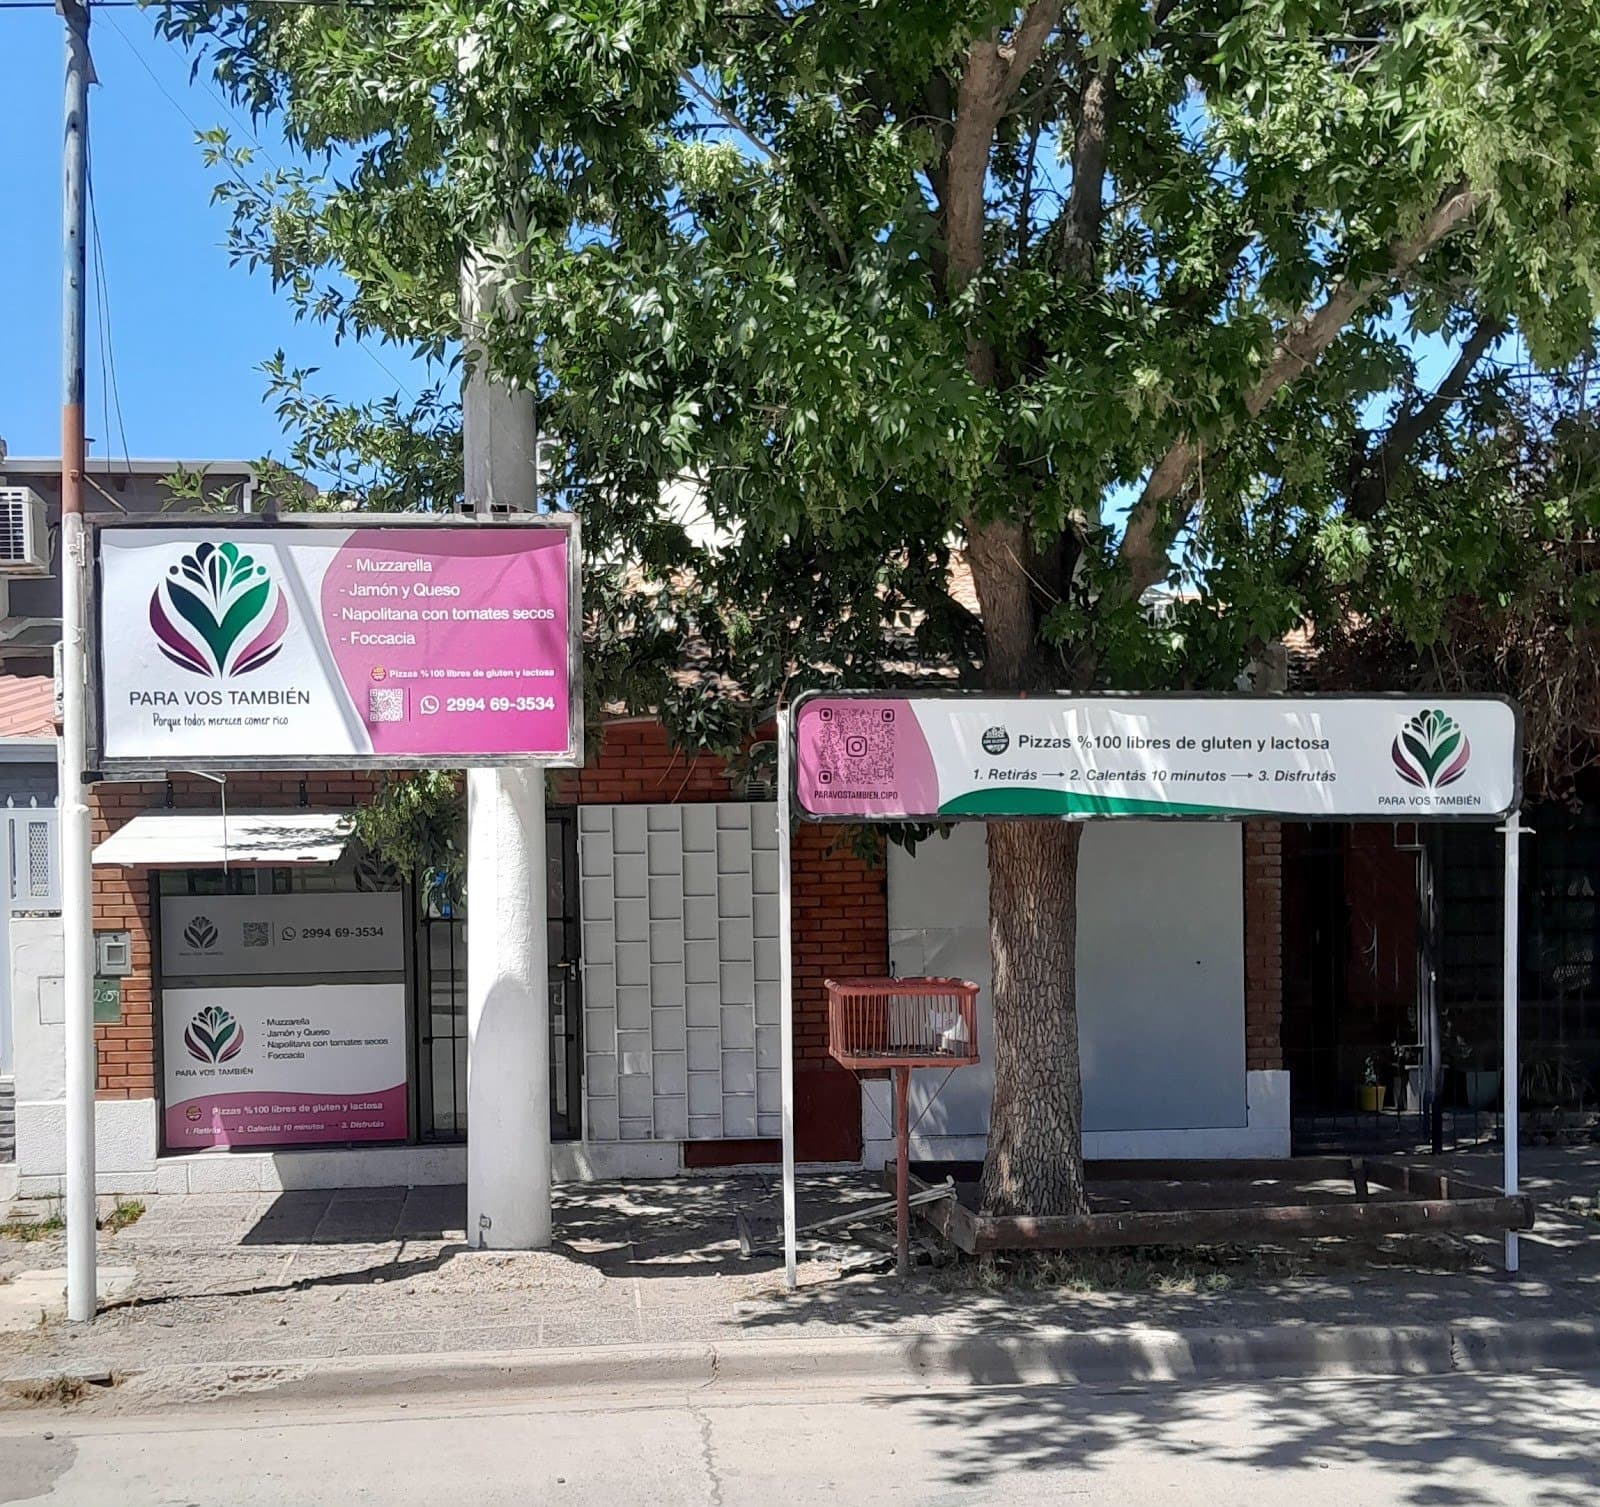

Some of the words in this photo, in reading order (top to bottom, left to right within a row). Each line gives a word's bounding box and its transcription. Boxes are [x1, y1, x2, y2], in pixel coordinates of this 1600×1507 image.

[356, 559, 433, 572] Muzzarella
[349, 583, 398, 596] Jamón
[402, 586, 410, 599] y
[413, 583, 460, 597] Queso
[342, 607, 418, 622] Napolitana
[422, 609, 448, 620] con
[452, 607, 509, 620] tomates
[513, 609, 555, 620] secos
[350, 631, 416, 645] Foccacia
[389, 670, 417, 678] Pizzas
[420, 670, 444, 678] %100
[446, 669, 471, 678] libres
[473, 669, 484, 678] de
[486, 669, 513, 679] gluten
[515, 670, 520, 679] y
[522, 669, 554, 677] lactosa
[129, 691, 179, 706] PARA
[184, 691, 223, 706] VOS
[228, 687, 310, 705] TAMBIÉN
[446, 697, 485, 711] 2994
[490, 697, 555, 711] 69-3534
[152, 712, 181, 732] Porque
[184, 713, 206, 727] todos
[208, 716, 242, 726] merecen
[244, 716, 270, 726] comer
[272, 716, 288, 726] rico
[1018, 735, 1071, 749] Pizzas
[1077, 735, 1122, 749] %100
[1127, 735, 1171, 749] libres
[1176, 736, 1196, 750] de
[1201, 736, 1252, 752] gluten
[1257, 739, 1266, 752] y
[1271, 736, 1330, 750] lactosa
[973, 769, 984, 780] 1.
[988, 768, 1037, 780] Retirás
[1070, 769, 1081, 781] 2.
[1086, 769, 1146, 781] Calentás
[1152, 770, 1167, 781] 10
[1171, 770, 1227, 781] minutos
[1258, 770, 1270, 782] 3.
[1274, 769, 1337, 782] Disfrutás
[1378, 796, 1406, 805] PARA
[1408, 796, 1431, 805] VOS
[1433, 794, 1481, 805] TAMBIÉN
[302, 928, 331, 939] 2994
[335, 926, 384, 938] 69-3534
[267, 1018, 310, 1026] Muzzarella
[267, 1027, 295, 1038] Jamón
[297, 1030, 301, 1039] y
[303, 1028, 330, 1037] Queso
[267, 1040, 311, 1049] Napolitana
[330, 1039, 362, 1047] tomates
[365, 1038, 389, 1046] secos
[268, 1051, 305, 1060] Foccacia
[218, 1067, 254, 1076] TAMBIÉN
[212, 1107, 241, 1116] Pizzas
[244, 1105, 270, 1114] %100
[272, 1104, 297, 1113] libres
[299, 1104, 310, 1113] de
[312, 1103, 341, 1114] gluten
[342, 1104, 348, 1113] y
[350, 1102, 384, 1111] lactosa
[193, 1127, 221, 1135] Retirás
[247, 1124, 281, 1133] Calentás
[283, 1123, 293, 1131] 10
[293, 1123, 325, 1131] minutos
[350, 1120, 385, 1129] Disfrutás
